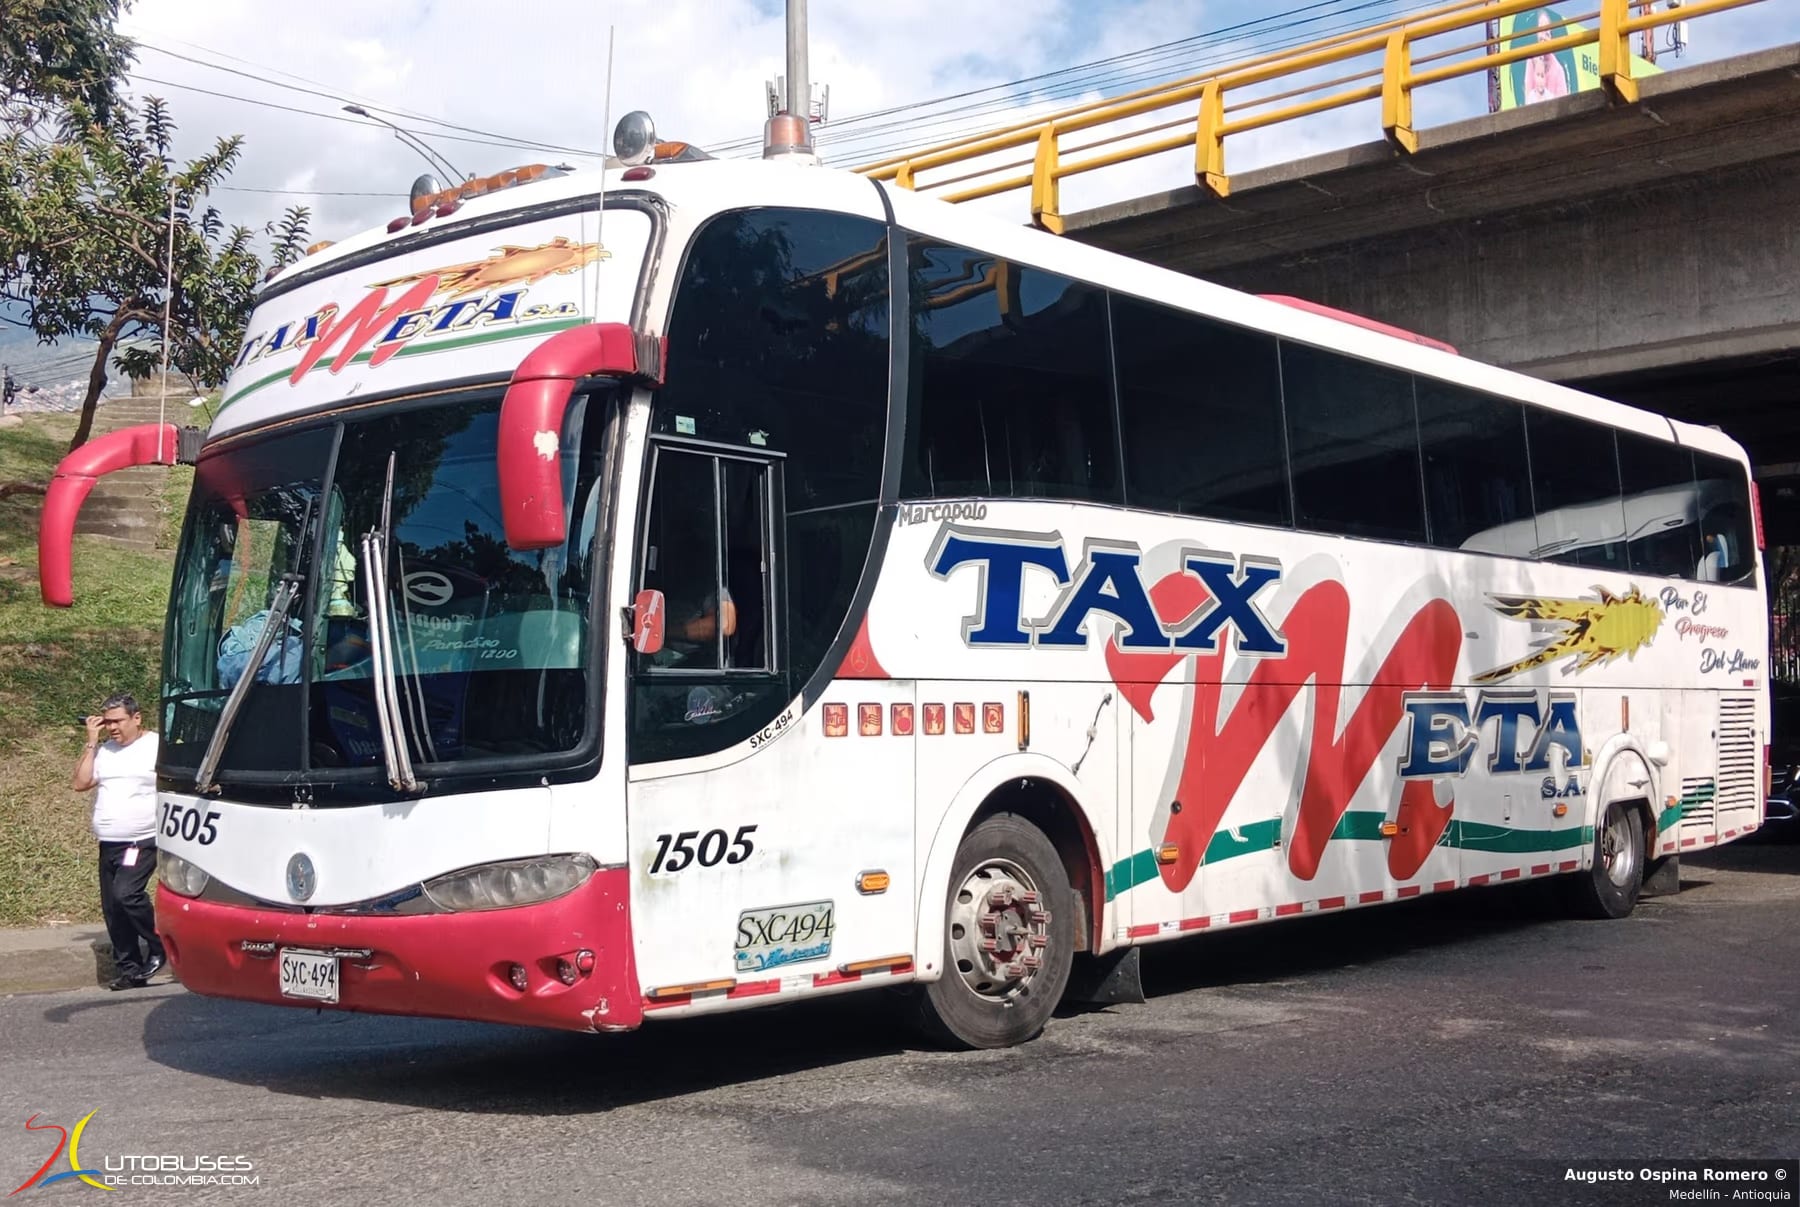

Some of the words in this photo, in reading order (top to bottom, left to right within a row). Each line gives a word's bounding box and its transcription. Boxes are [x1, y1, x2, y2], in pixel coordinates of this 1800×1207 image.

[1582, 53, 1600, 76] Bie
[233, 305, 341, 368] TAX
[899, 502, 988, 527] Marcopolo
[925, 521, 1288, 659] TAX
[1660, 586, 1689, 614] Por
[1691, 591, 1708, 616] El
[1675, 616, 1729, 643] Progreso
[480, 649, 518, 659] 1200
[1700, 648, 1726, 674] Del
[1727, 649, 1760, 675] Llano
[1541, 775, 1586, 800] S.A.
[160, 802, 222, 846] 1505
[650, 824, 758, 874] 1505
[735, 908, 834, 949] SXC494
